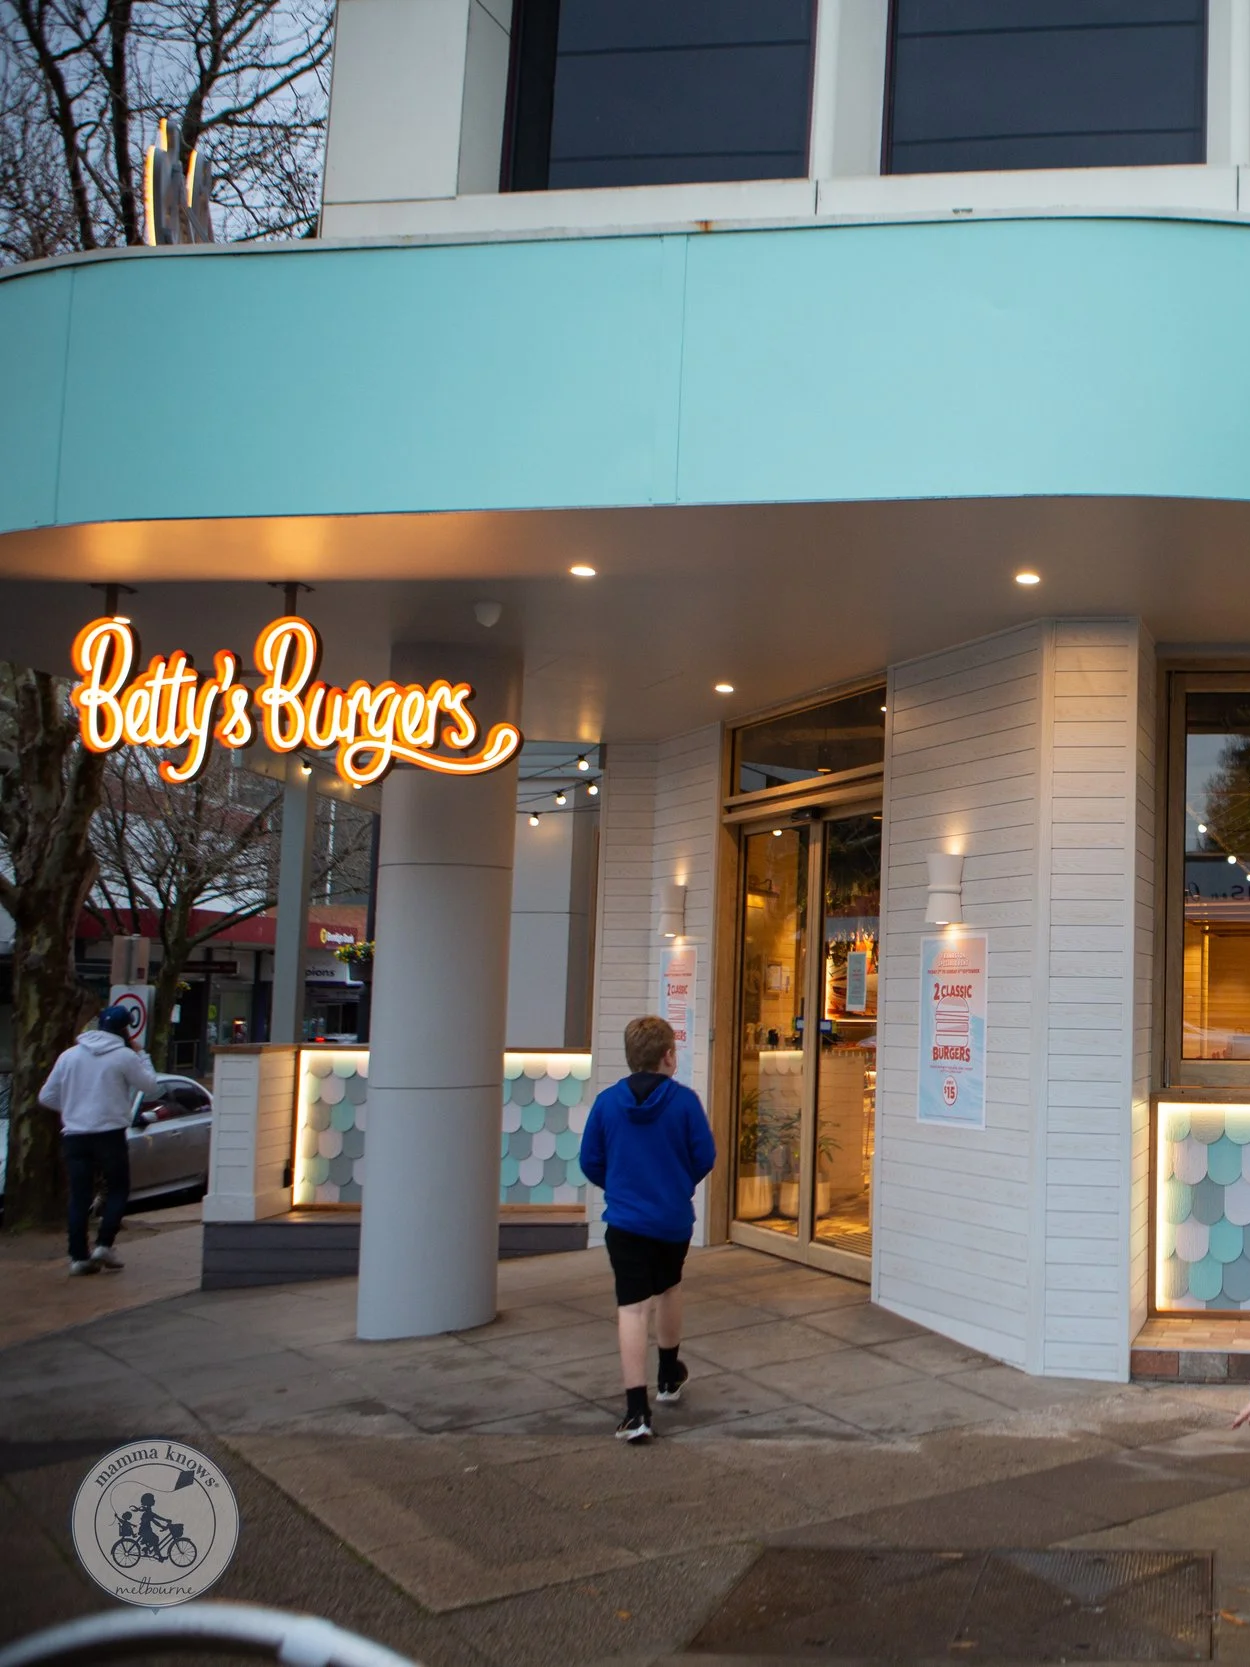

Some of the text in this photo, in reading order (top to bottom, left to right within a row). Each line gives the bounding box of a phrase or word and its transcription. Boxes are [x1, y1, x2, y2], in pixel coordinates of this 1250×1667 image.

[71, 615, 524, 785] Betty's Burgers
[933, 982, 973, 1000] 2 CLASSIC
[932, 1045, 971, 1063] BURGERS
[943, 1085, 956, 1100] $15
